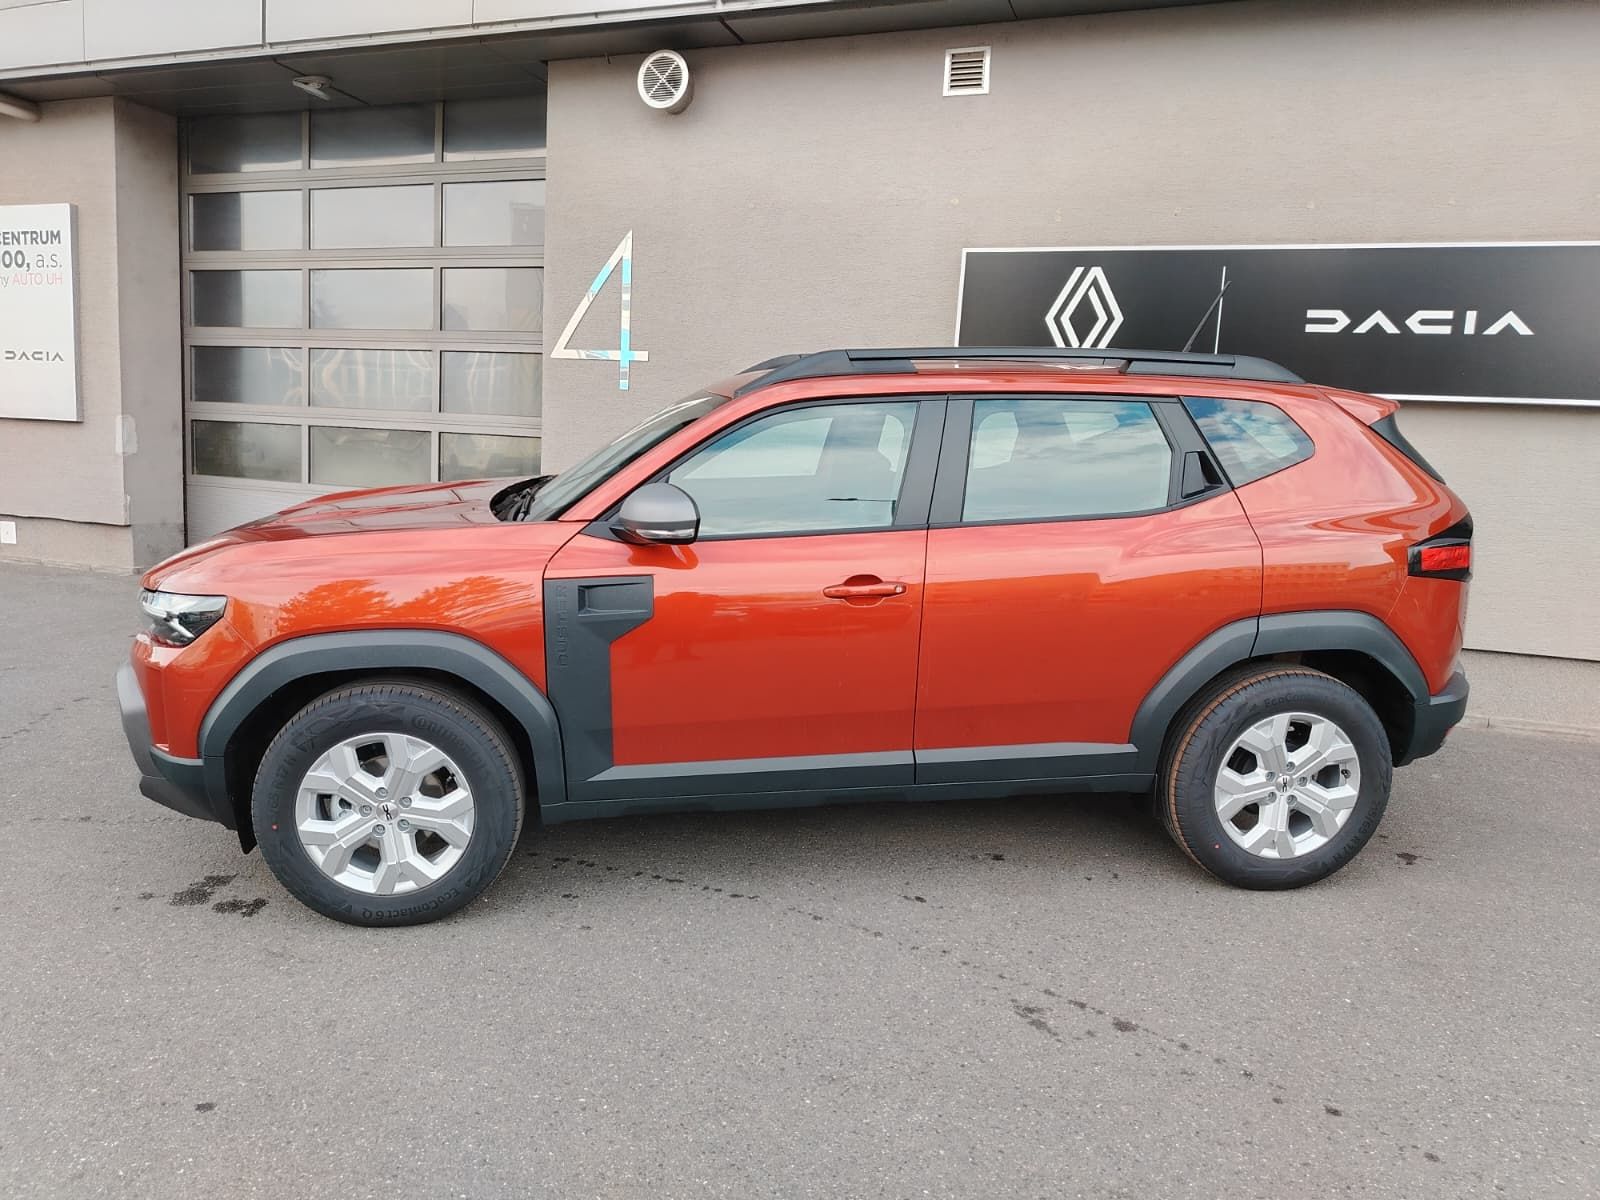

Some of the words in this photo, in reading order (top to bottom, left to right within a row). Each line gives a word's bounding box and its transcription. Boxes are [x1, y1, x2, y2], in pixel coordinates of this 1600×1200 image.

[0, 230, 61, 246] ENTRUM
[36, 254, 63, 268] a.s.
[12, 272, 43, 286] AUTO
[46, 272, 63, 285] UH
[550, 229, 649, 391] 4
[1304, 309, 1535, 336] DACIA
[4, 350, 64, 362] DACIA
[387, 886, 462, 919] EcoContact
